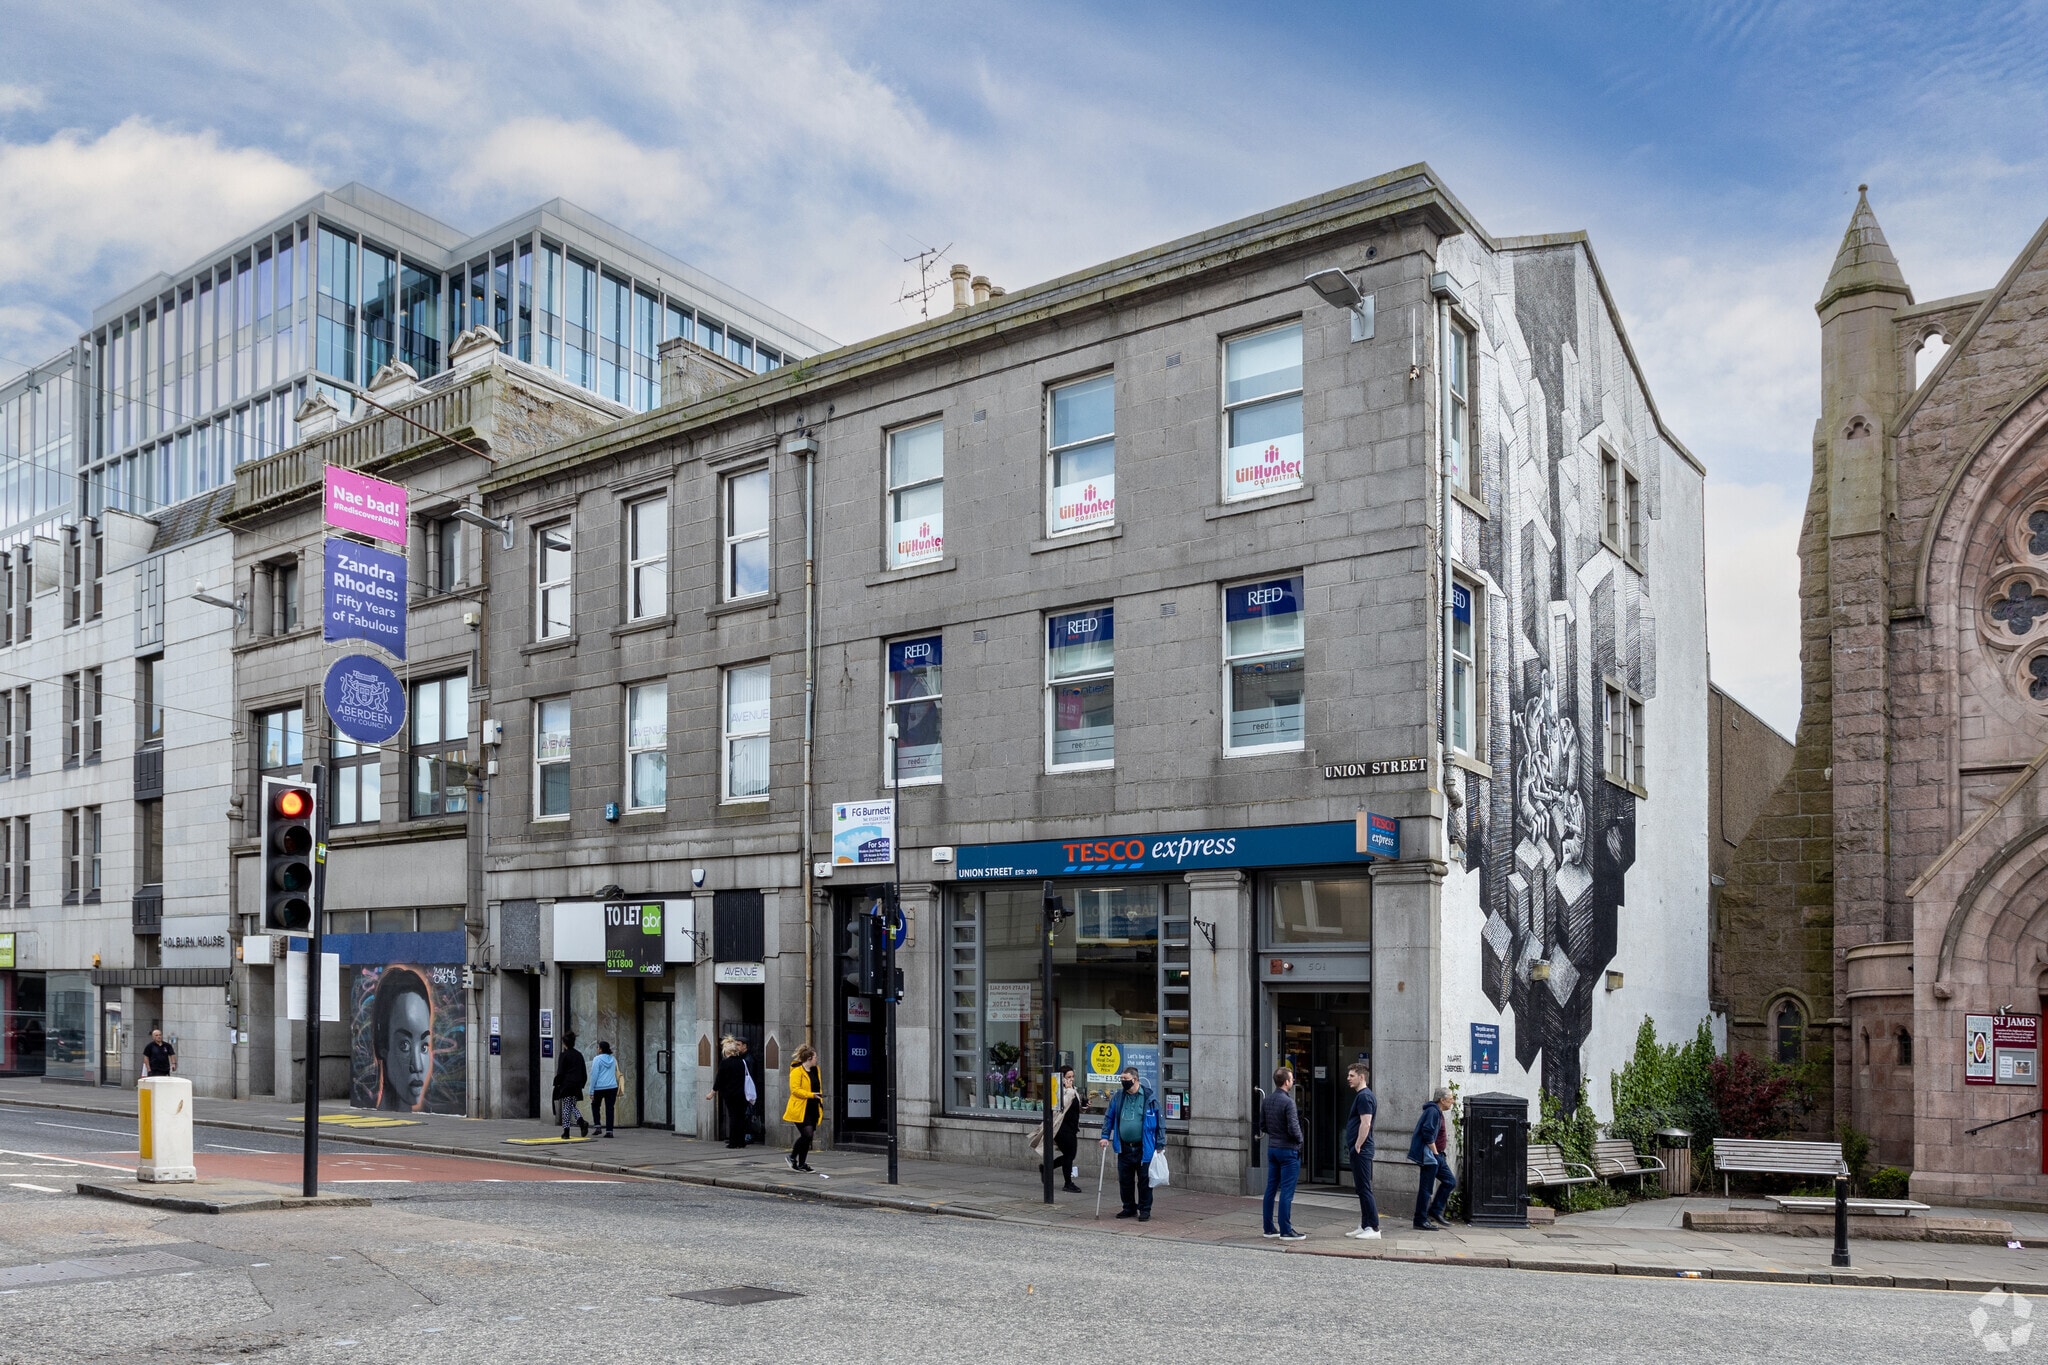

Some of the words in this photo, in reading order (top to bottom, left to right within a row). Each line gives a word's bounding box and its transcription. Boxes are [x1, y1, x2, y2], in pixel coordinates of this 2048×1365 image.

[1236, 460, 1301, 483] LiliHunter
[1254, 472, 1300, 486] CONSULTING
[333, 485, 363, 506] Nae
[366, 494, 399, 517] bad!
[1060, 498, 1115, 519] LiliHunter
[333, 502, 400, 527] #RediscoverABDN
[338, 554, 395, 583] Zandra
[334, 572, 398, 602] Rhodes:
[1248, 587, 1283, 606] REED
[336, 593, 362, 612] Fifty
[365, 600, 396, 618] Years
[332, 610, 346, 621] of
[348, 613, 399, 634] Fabulous
[1068, 617, 1098, 635] REED
[905, 643, 931, 659] REED
[1242, 659, 1296, 674] frontier
[1062, 683, 1109, 697] frontier
[337, 704, 392, 725] ABERDEEN
[343, 715, 357, 723] CITY
[731, 709, 769, 722] AVENUE
[1325, 763, 1366, 778] UNION
[1372, 758, 1427, 774] STREET
[852, 808, 861, 816] FG
[863, 806, 890, 816] Burnett
[1371, 815, 1396, 832] TESCO
[1371, 834, 1394, 847] express
[1062, 840, 1145, 863] TESCO
[1151, 837, 1236, 864] express
[958, 868, 984, 878] UNION
[985, 867, 1013, 877] STREET
[606, 906, 620, 926] TO
[623, 905, 641, 926] LET
[163, 936, 194, 948] HOLBURN
[198, 935, 224, 947] HOUSE
[607, 950, 625, 959] 01224
[607, 959, 633, 968] 611800
[724, 966, 758, 976] AVENUE
[1993, 1016, 2005, 1026] ST
[2006, 1017, 2036, 1028] JAMES
[851, 1048, 867, 1056] REED
[1099, 1045, 1113, 1057] £3
